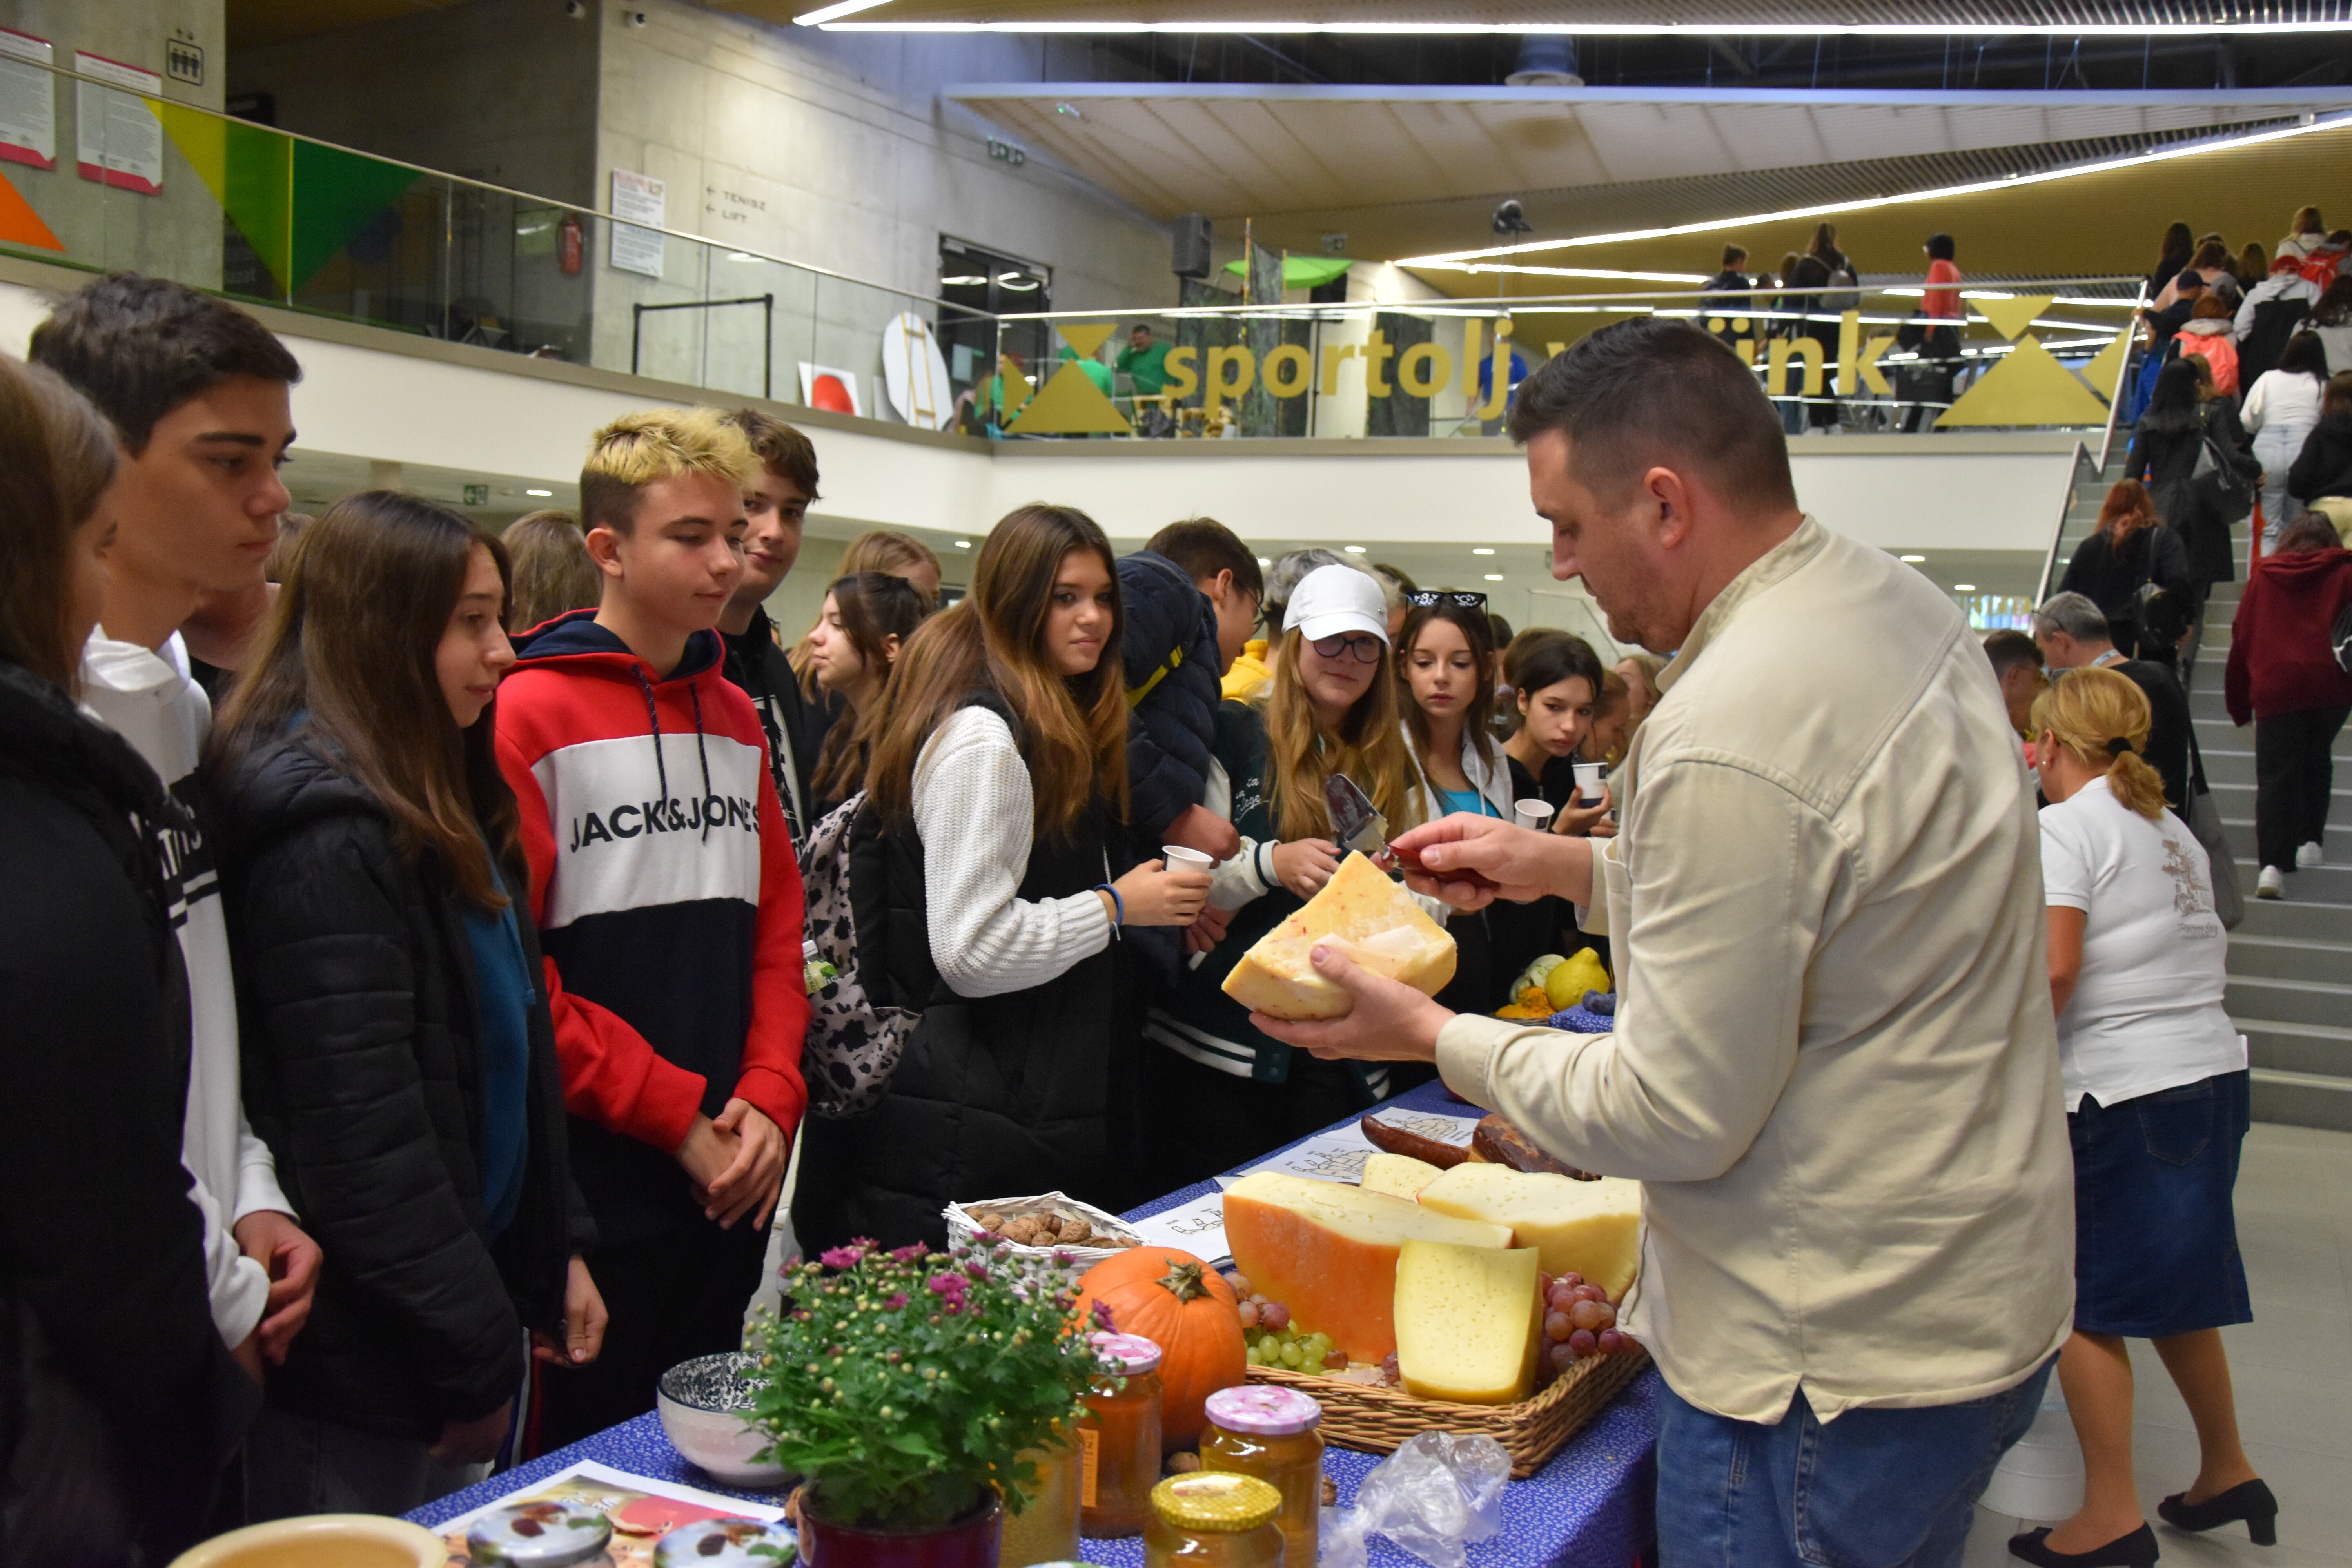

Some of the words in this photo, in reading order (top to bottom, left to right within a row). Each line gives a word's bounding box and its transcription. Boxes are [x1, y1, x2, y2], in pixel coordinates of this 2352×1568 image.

[723, 191, 766, 211] TENISZ
[722, 211, 746, 223] LIFT
[1162, 318, 1514, 421] sportolj
